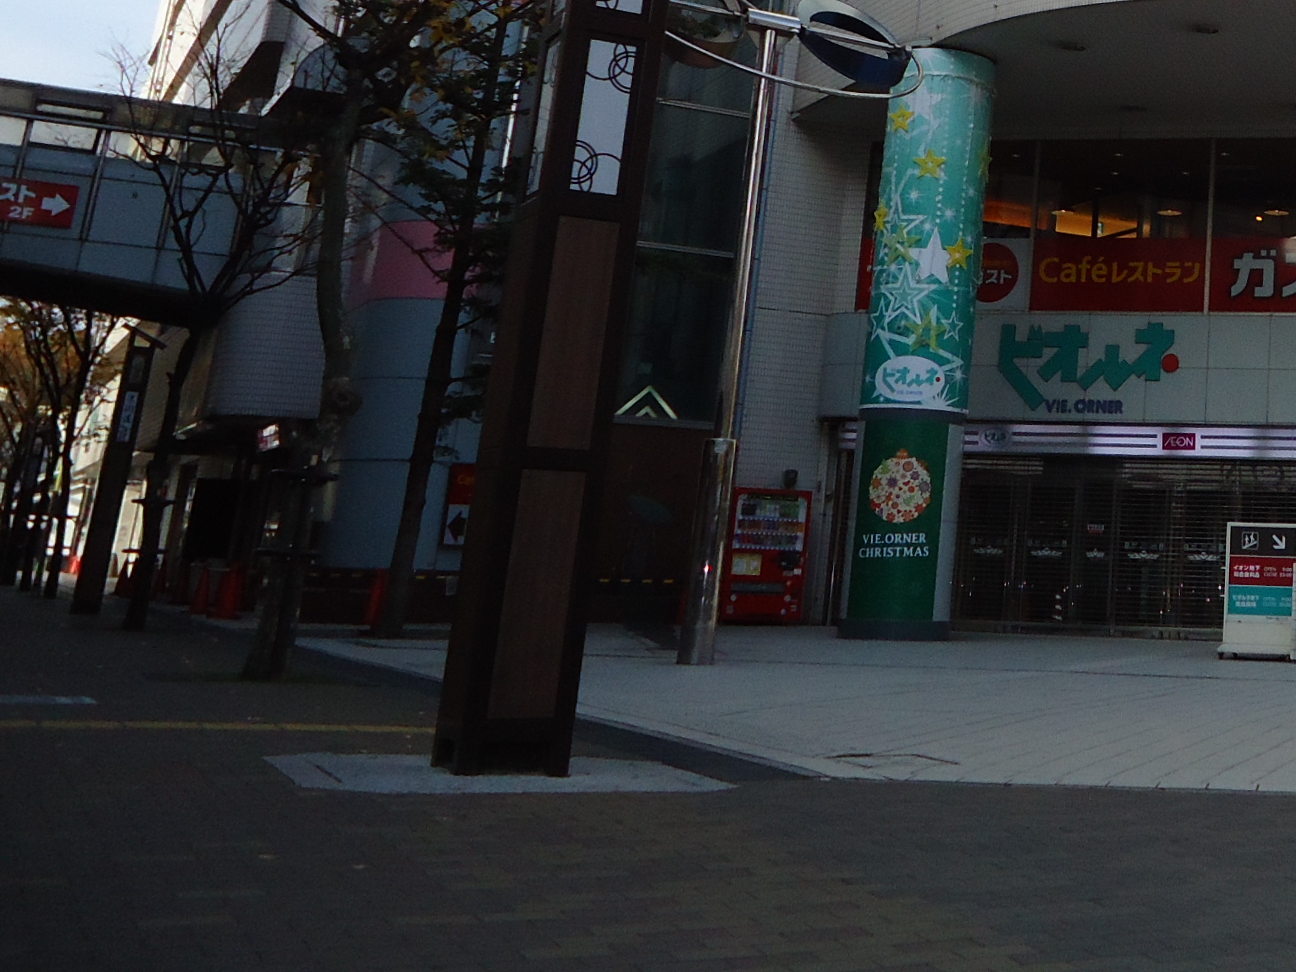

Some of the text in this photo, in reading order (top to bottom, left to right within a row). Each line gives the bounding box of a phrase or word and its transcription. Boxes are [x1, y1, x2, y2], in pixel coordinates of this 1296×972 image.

[8, 205, 35, 219] 2F
[998, 322, 1176, 412] ビオルネ
[862, 532, 927, 545] VIE.ORNER
[858, 546, 930, 559] CHRISTMAS
